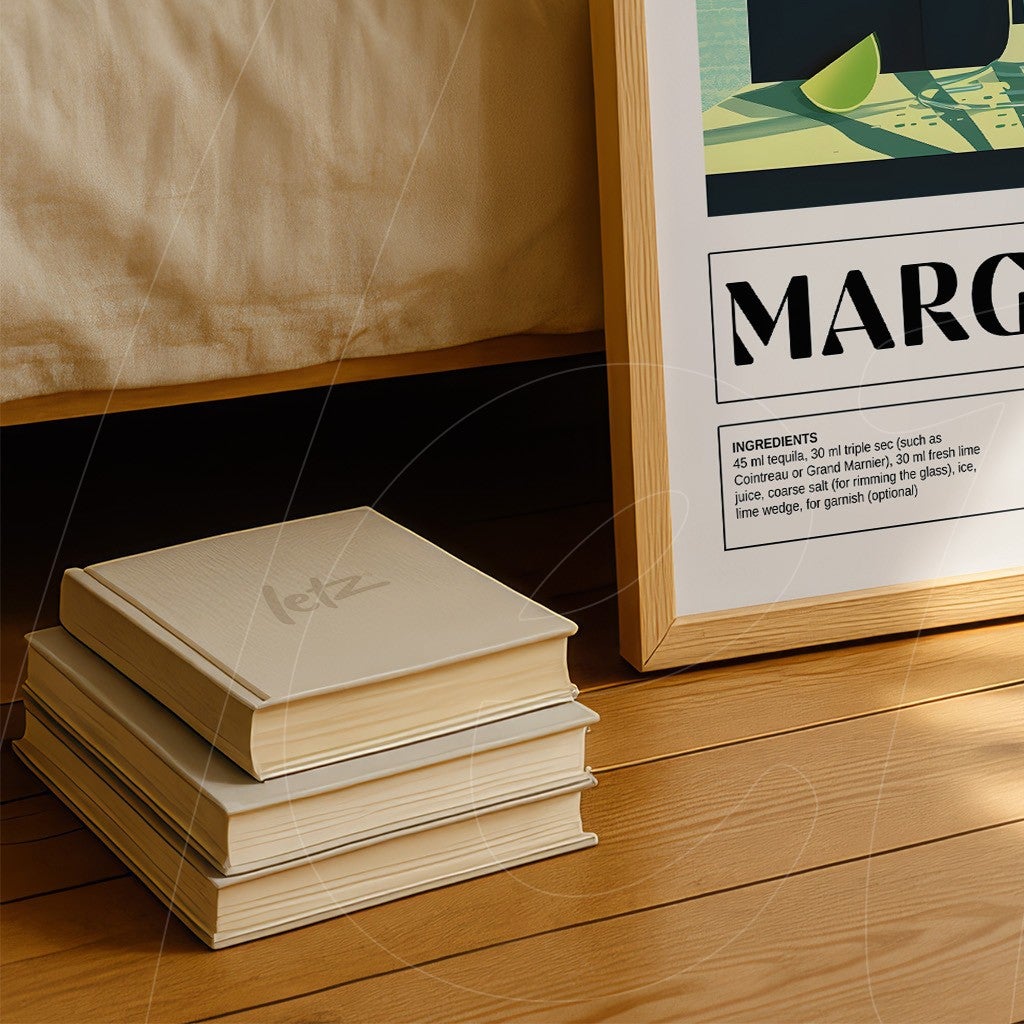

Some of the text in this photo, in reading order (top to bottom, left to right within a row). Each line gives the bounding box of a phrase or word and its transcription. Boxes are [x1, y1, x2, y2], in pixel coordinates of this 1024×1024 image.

[732, 432, 818, 453] INGREDIENTS
[733, 434, 942, 469] 45 ml tequila, 30 ml triple sec (such as
[734, 445, 980, 486] Cointreau or Grand Marnier), 30 ml fresh lime
[735, 461, 977, 506] juice, coarse salt (for rimming the glass), ice,
[735, 484, 918, 519] lime wedge, for garnish (optional)
[262, 575, 391, 625] letz
